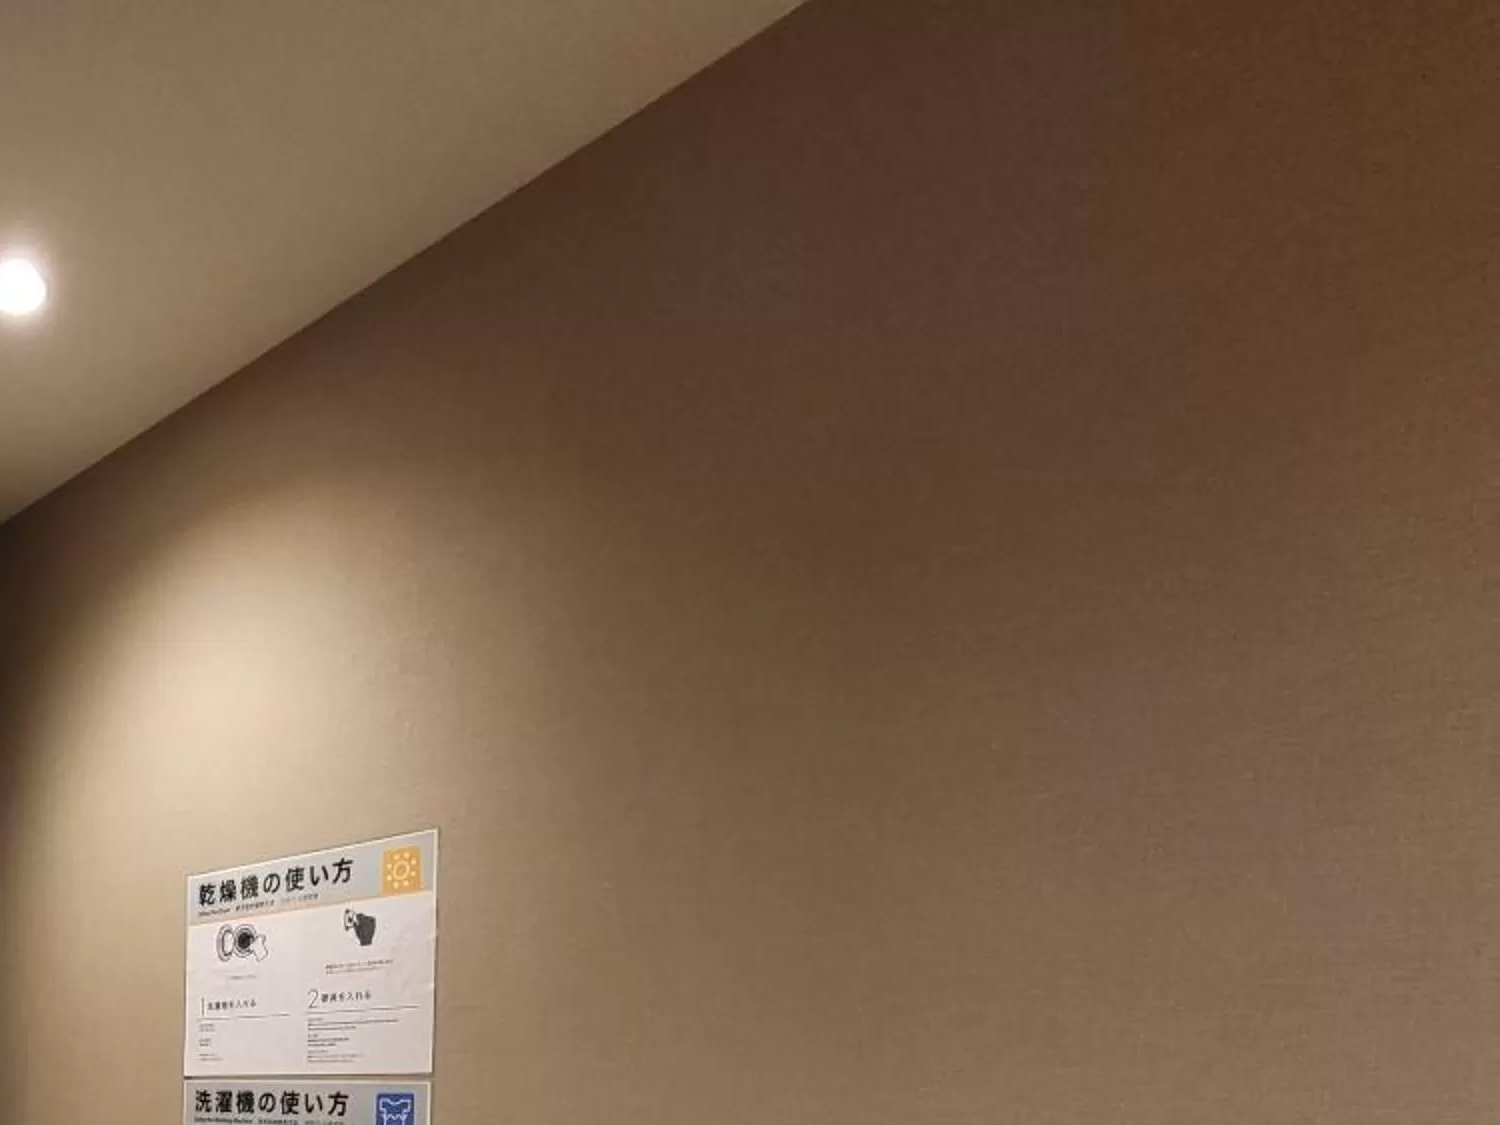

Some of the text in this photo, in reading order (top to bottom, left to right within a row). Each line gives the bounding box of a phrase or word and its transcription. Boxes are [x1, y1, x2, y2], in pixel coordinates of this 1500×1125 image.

[199, 857, 353, 907] 乾燥機の使い方
[195, 1089, 349, 1117] 洗濯機の使い方
